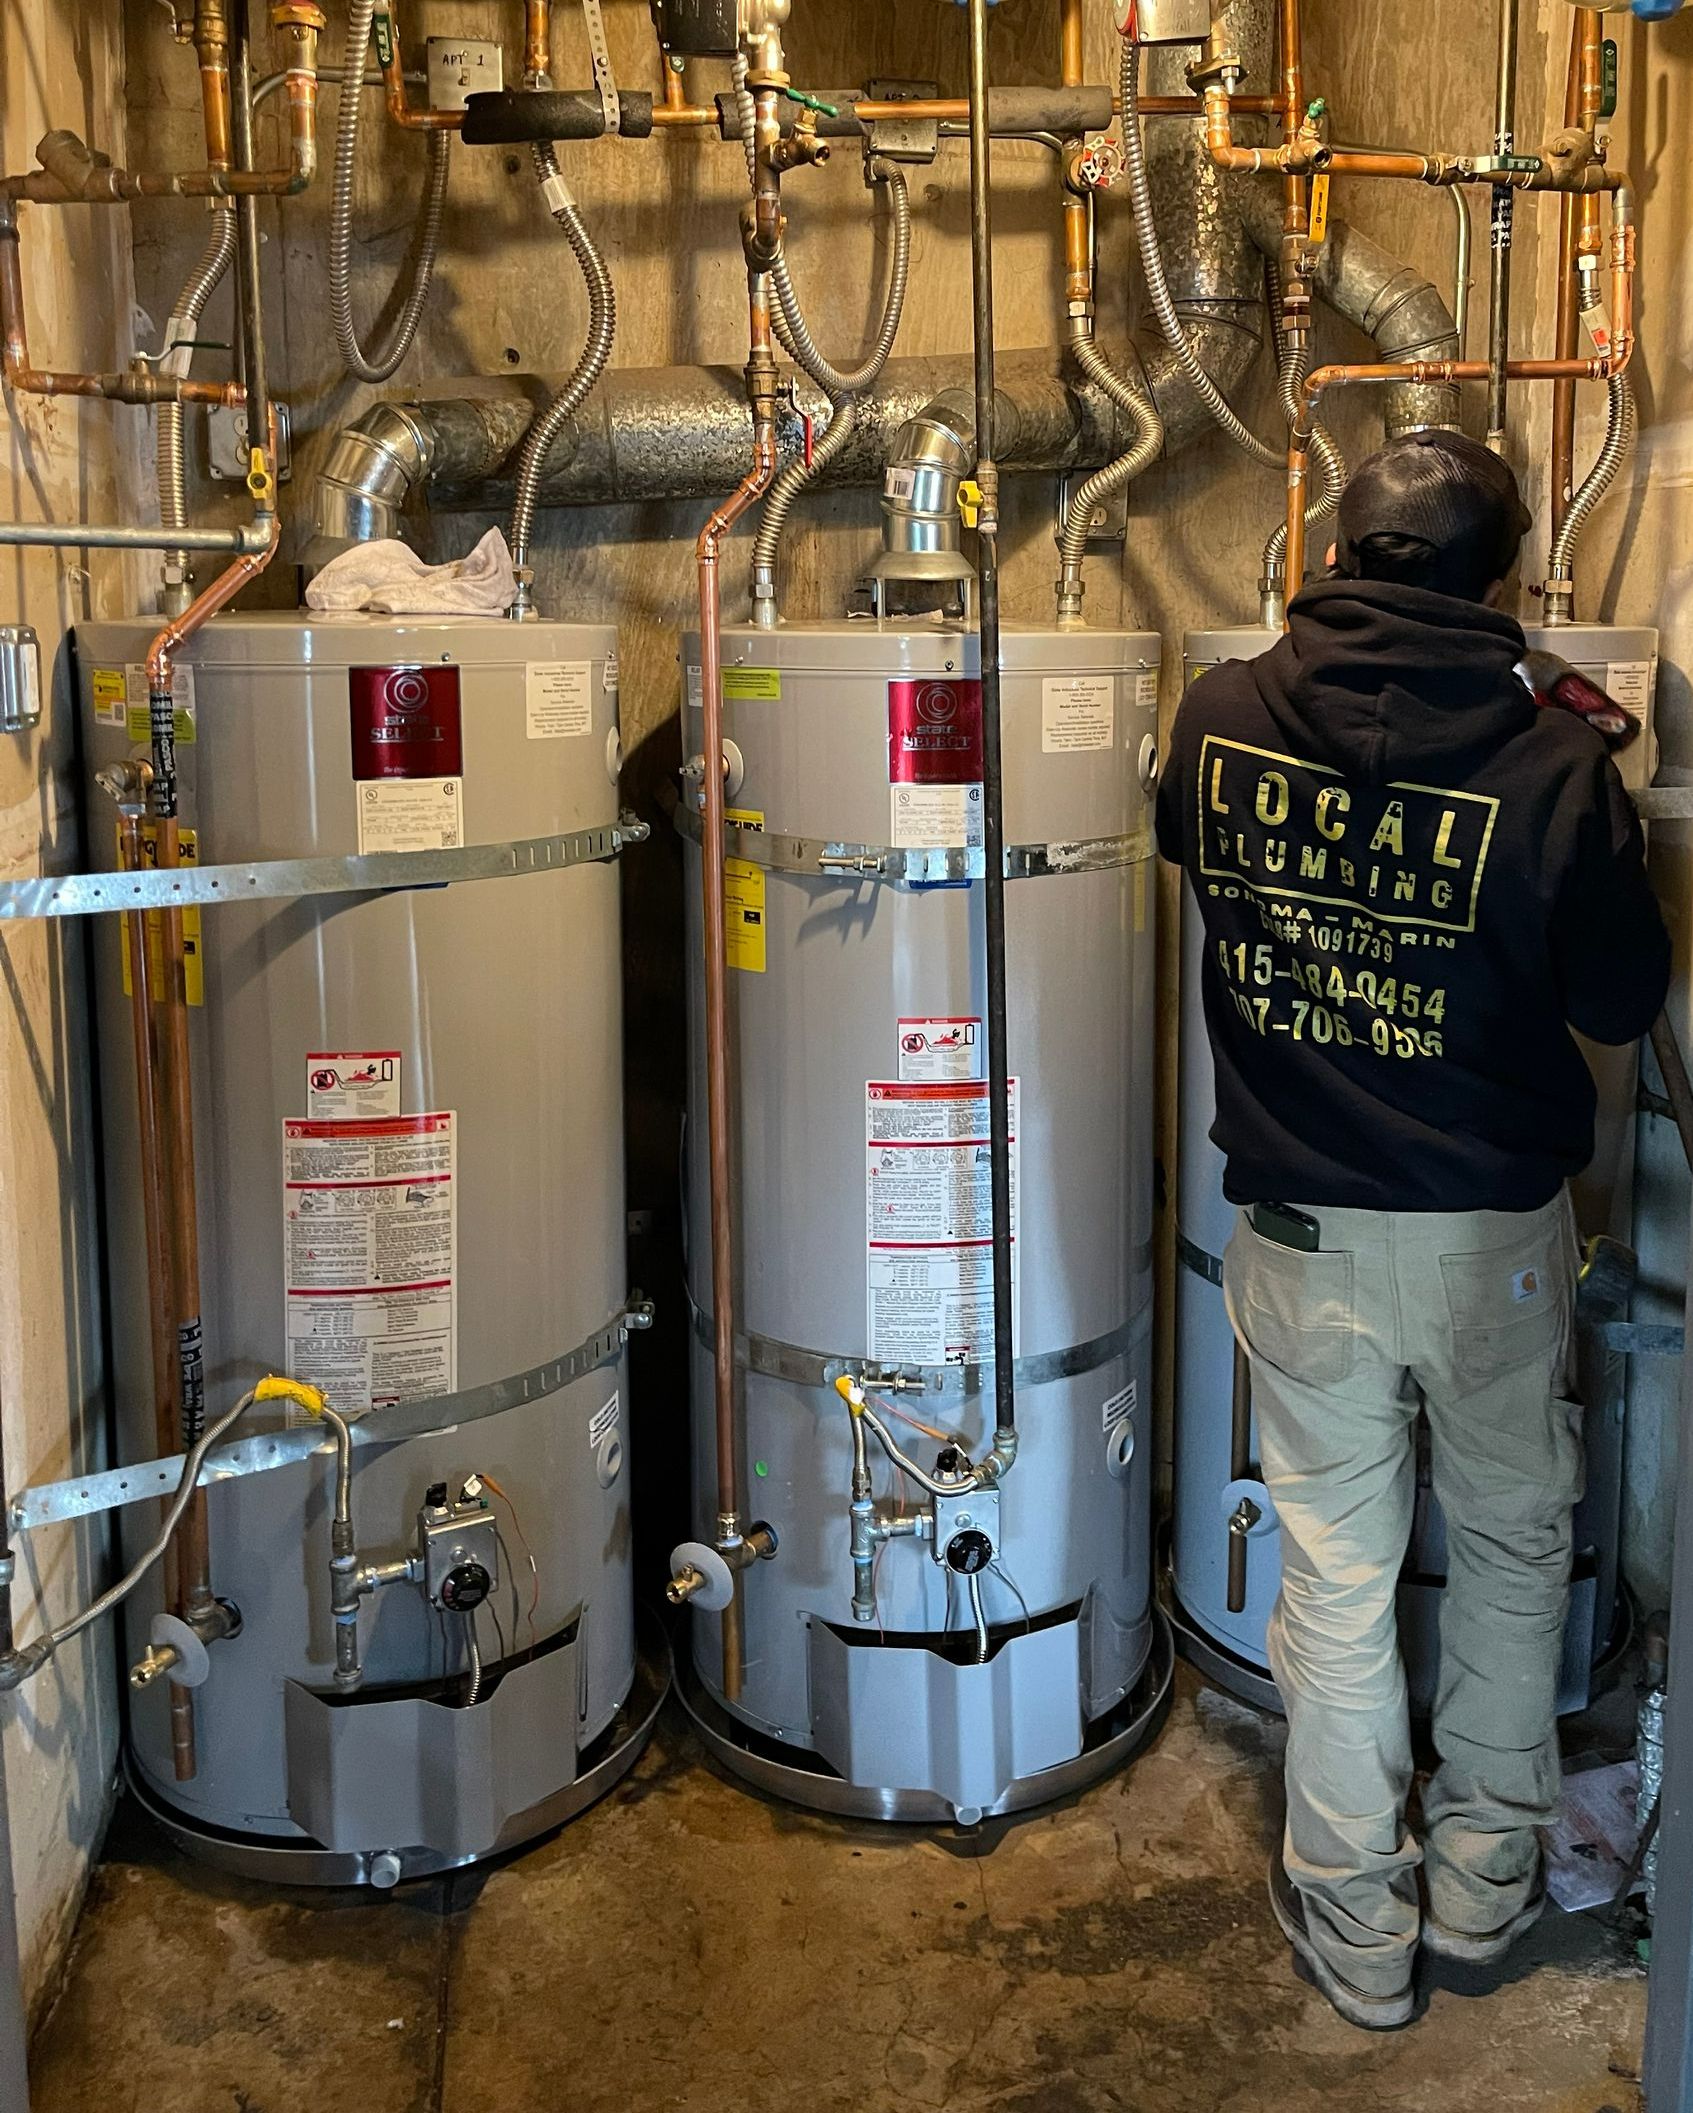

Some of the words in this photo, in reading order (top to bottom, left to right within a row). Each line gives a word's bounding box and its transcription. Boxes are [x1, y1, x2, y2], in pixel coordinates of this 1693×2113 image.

[442, 53, 464, 66] APT
[476, 54, 484, 66] 1
[903, 736, 971, 748] SELECT
[1210, 757, 1462, 869] LOCAL
[1216, 826, 1453, 909] PLUMBING
[1207, 884, 1313, 922] SONOMA
[1352, 916, 1456, 949] MARIN
[1308, 924, 1393, 964] 1091739
